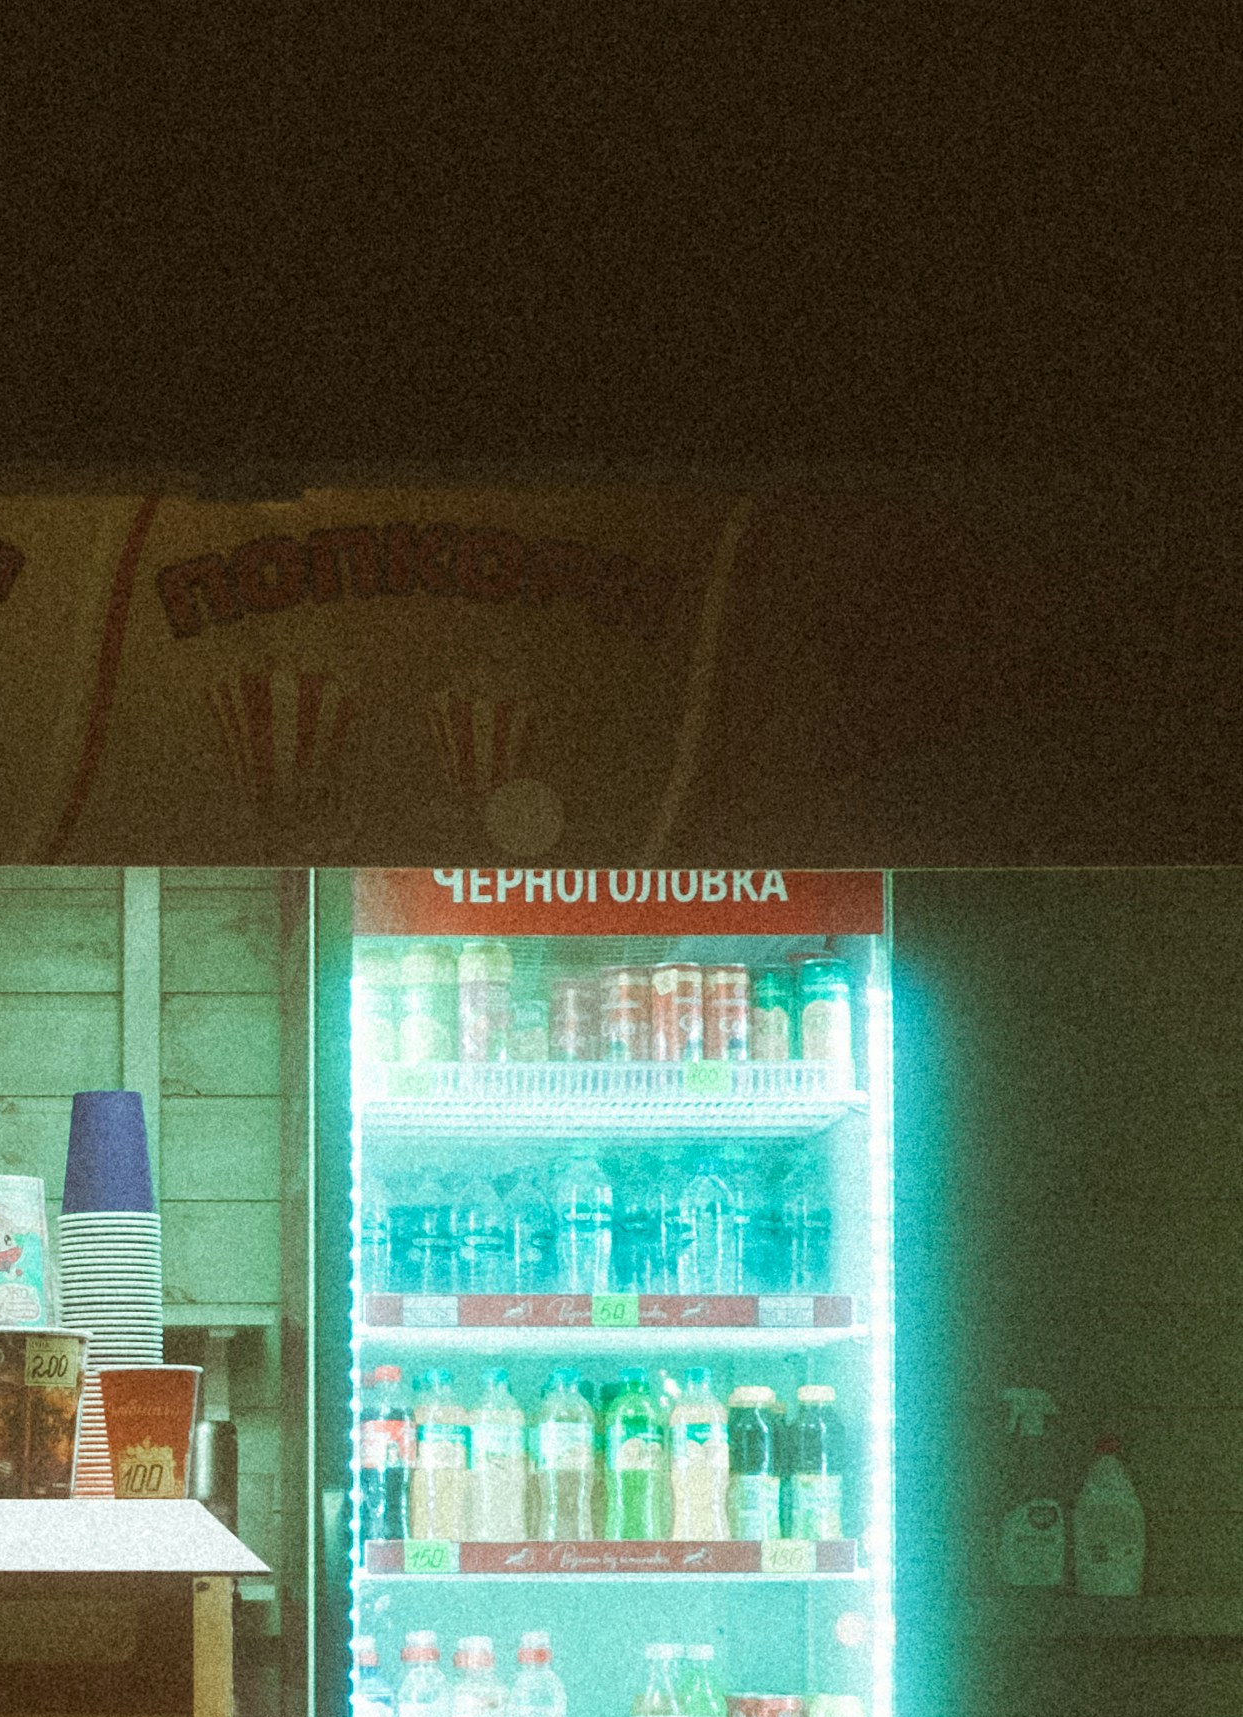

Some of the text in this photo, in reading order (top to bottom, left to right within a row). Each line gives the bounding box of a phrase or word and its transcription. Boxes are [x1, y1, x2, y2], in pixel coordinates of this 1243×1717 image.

[156, 521, 678, 640] ПОПКОРН
[433, 869, 789, 904] ЧЕРНОГОЛОВКА
[31, 1354, 69, 1379] 200
[124, 1464, 165, 1492] 100
[410, 1548, 444, 1568] 150
